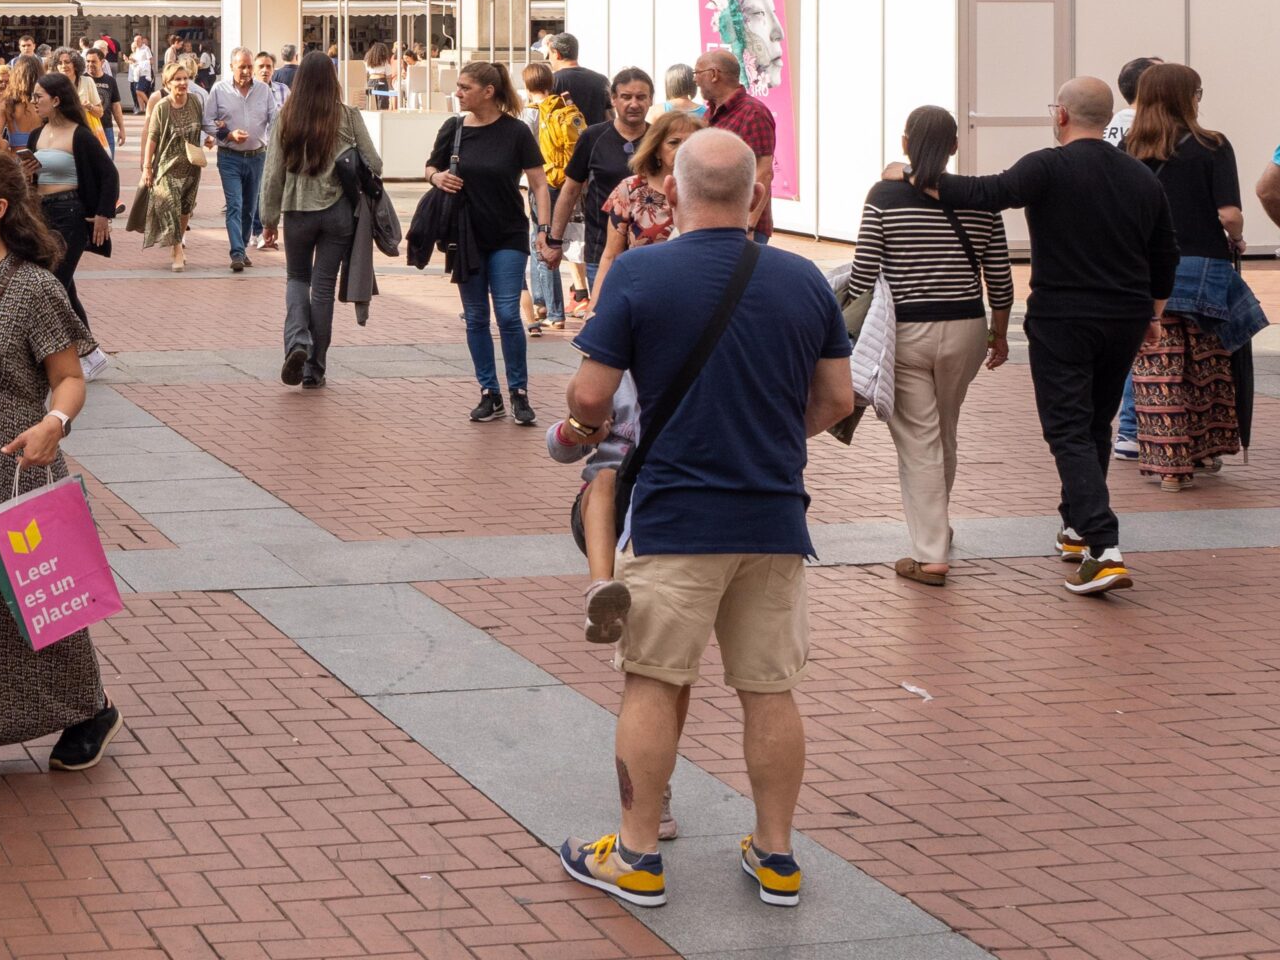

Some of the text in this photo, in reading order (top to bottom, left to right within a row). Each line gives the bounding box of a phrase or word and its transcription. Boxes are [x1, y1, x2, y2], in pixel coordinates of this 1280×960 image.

[15, 556, 59, 587] Leer
[24, 588, 47, 608] es
[50, 575, 76, 596] un
